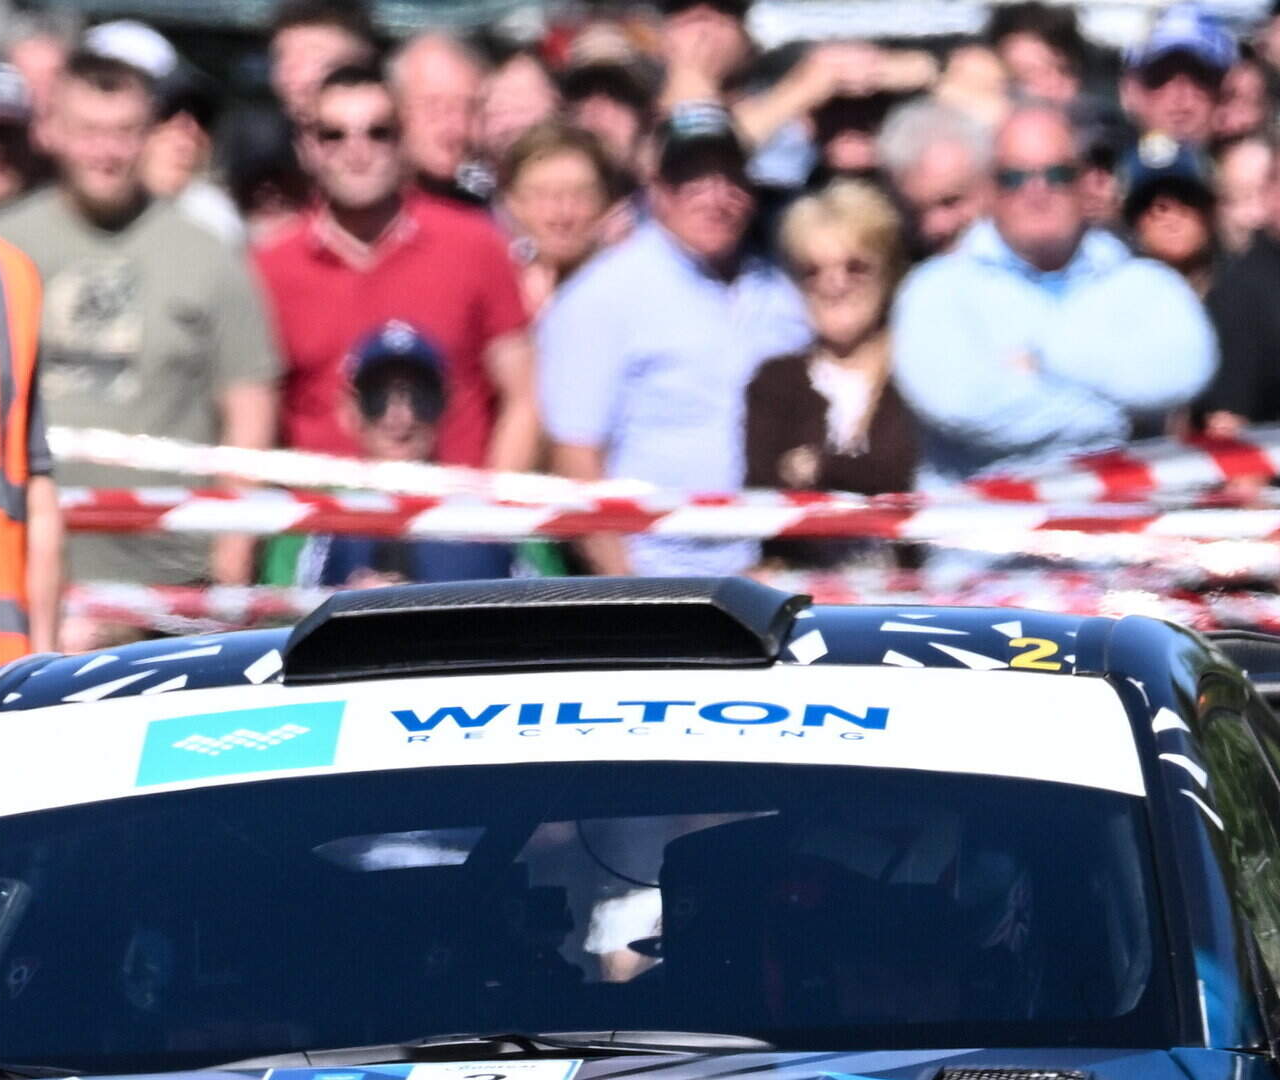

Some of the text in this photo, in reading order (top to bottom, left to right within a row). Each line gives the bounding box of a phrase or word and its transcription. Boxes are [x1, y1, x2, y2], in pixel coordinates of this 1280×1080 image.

[1009, 636, 1063, 670] 2
[389, 699, 891, 731] WILTON
[407, 726, 866, 744] RECYCLING
